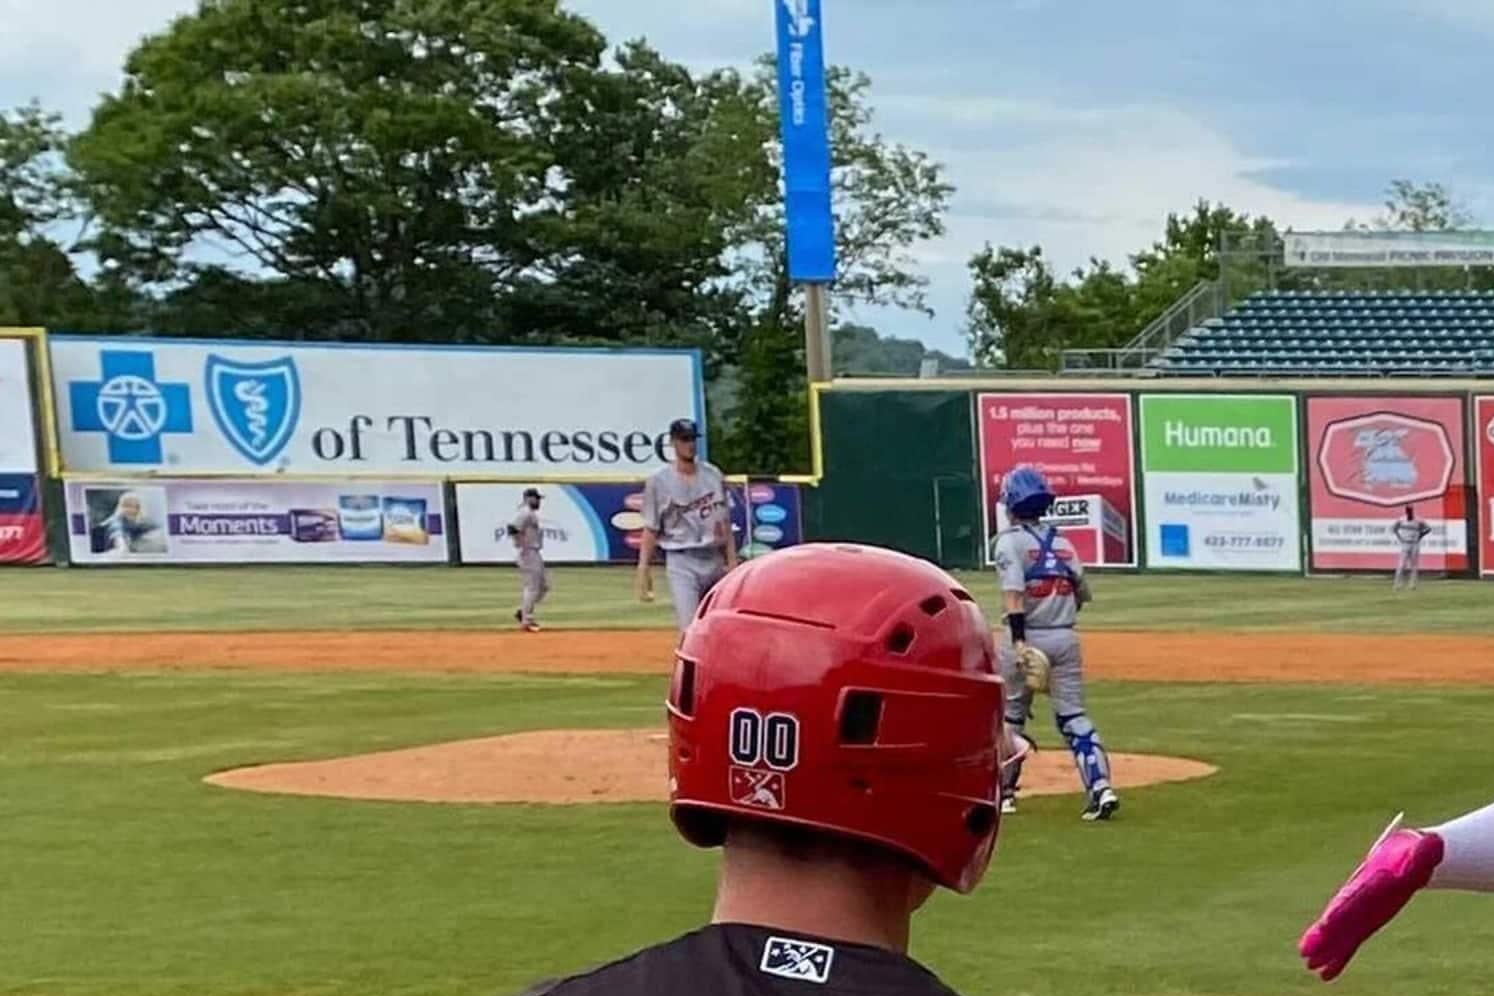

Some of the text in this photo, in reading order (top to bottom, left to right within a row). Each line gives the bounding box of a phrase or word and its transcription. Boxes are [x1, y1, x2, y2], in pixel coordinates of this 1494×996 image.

[1010, 406, 1055, 420] million
[312, 414, 674, 464] of Tennessee
[1164, 419, 1272, 448] Humana
[180, 516, 280, 534] Moments
[729, 707, 800, 772] 00
